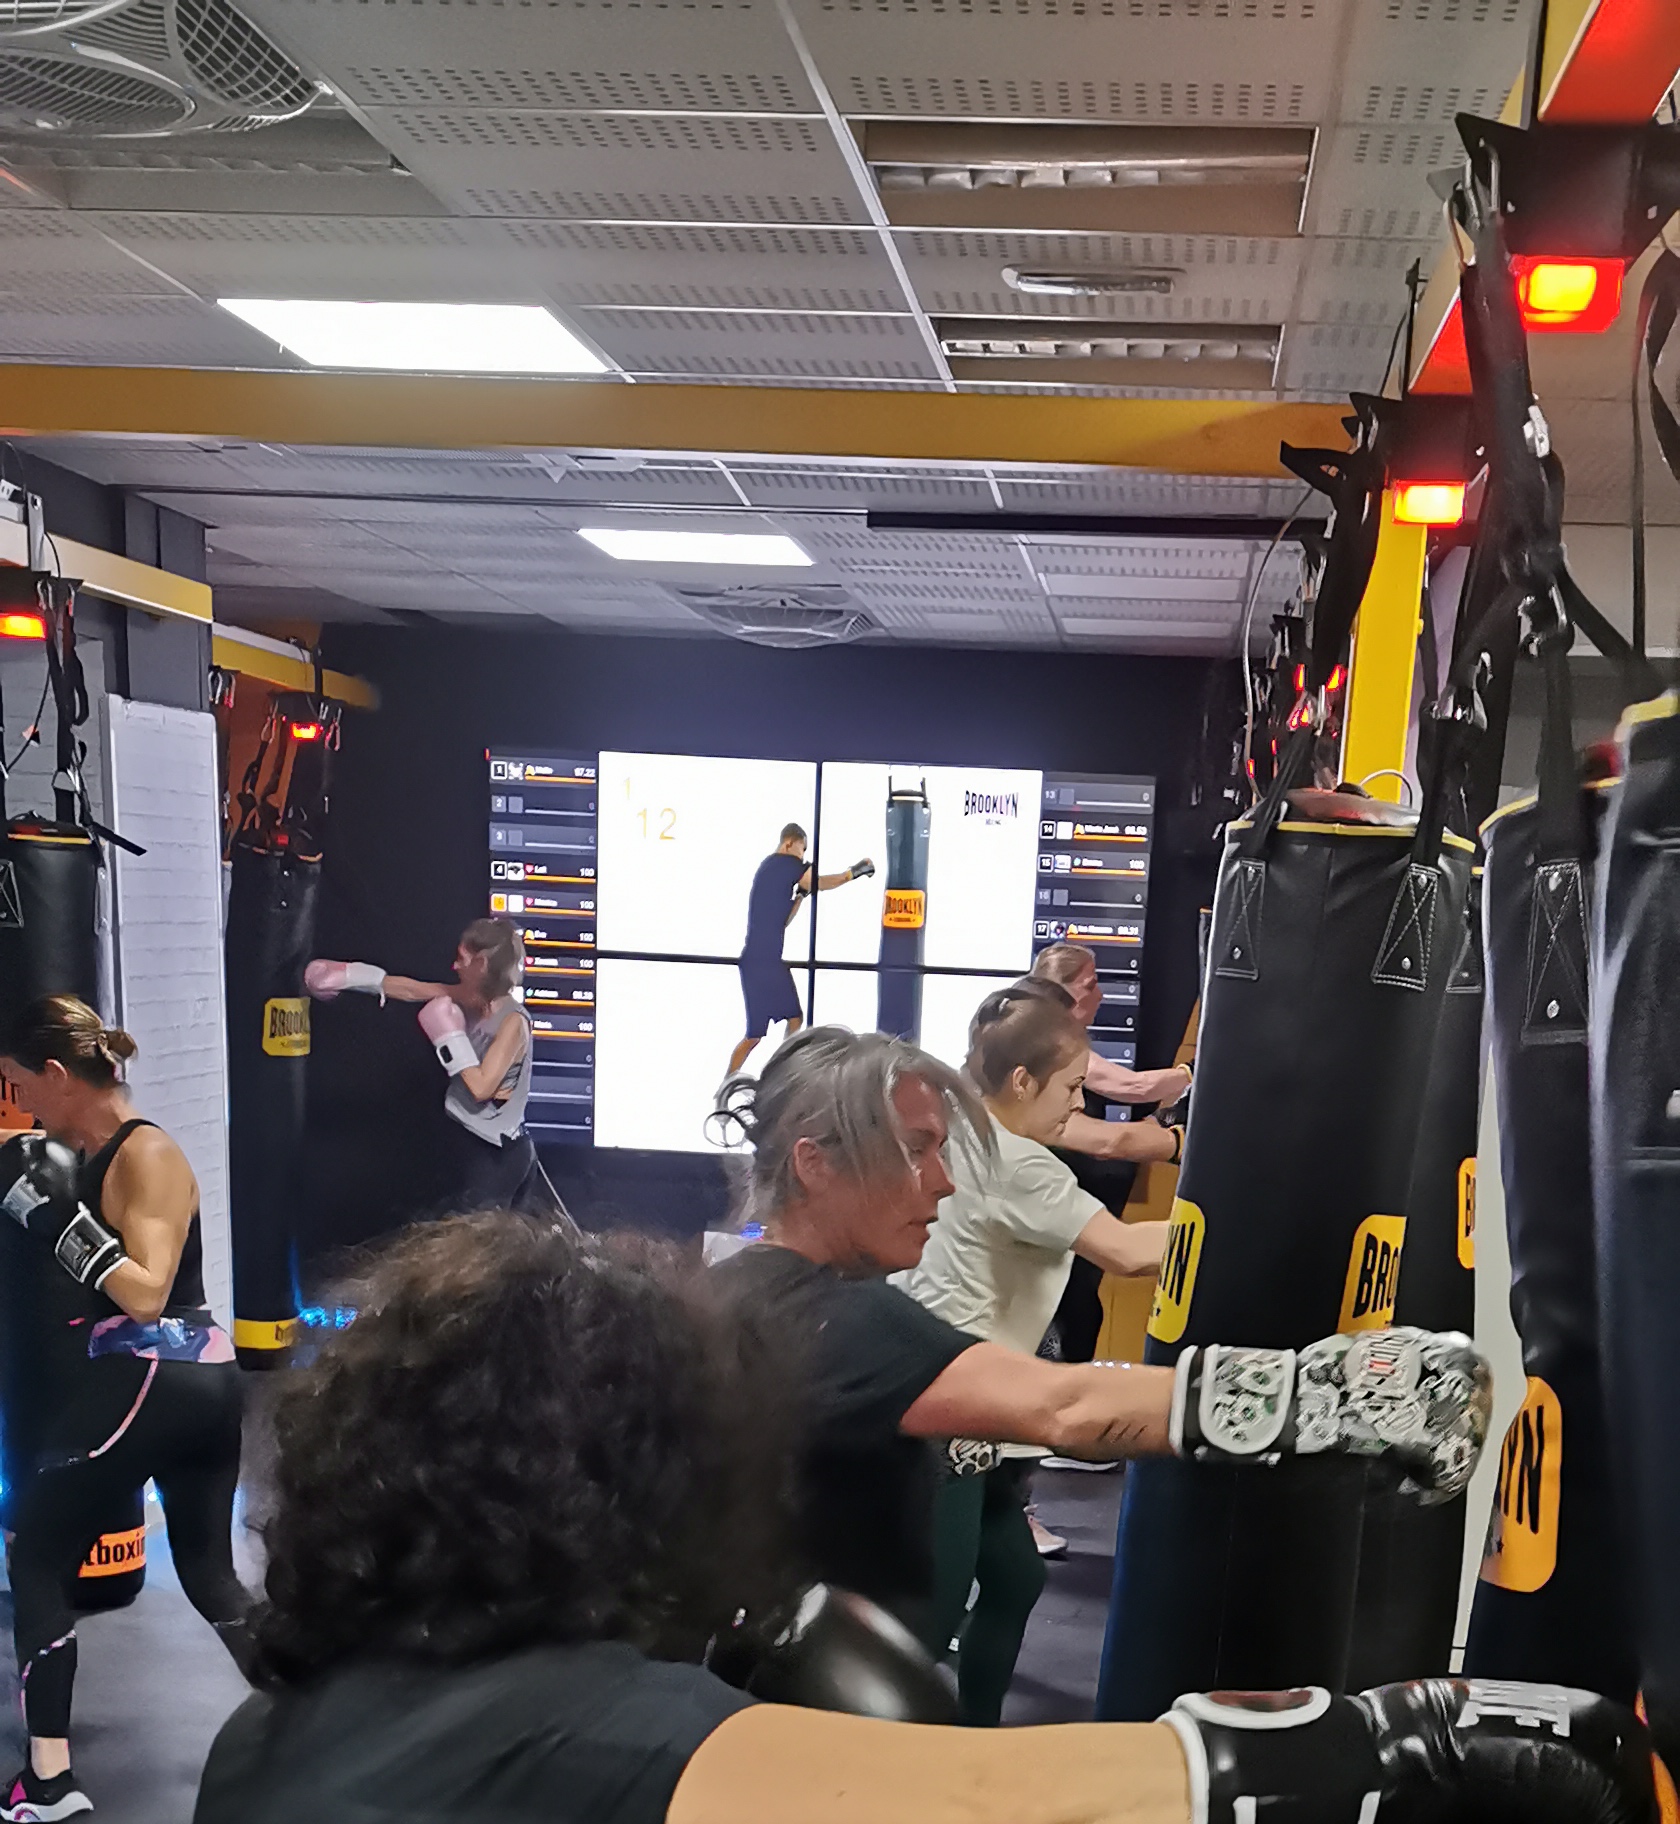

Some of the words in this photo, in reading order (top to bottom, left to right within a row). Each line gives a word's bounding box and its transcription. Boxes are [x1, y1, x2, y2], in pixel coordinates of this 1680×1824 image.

[963, 790, 1019, 818] BROOKLYN
[579, 867, 595, 877] 100
[579, 900, 595, 909] 100
[579, 932, 594, 942] 100
[1500, 1403, 1544, 1535] YN
